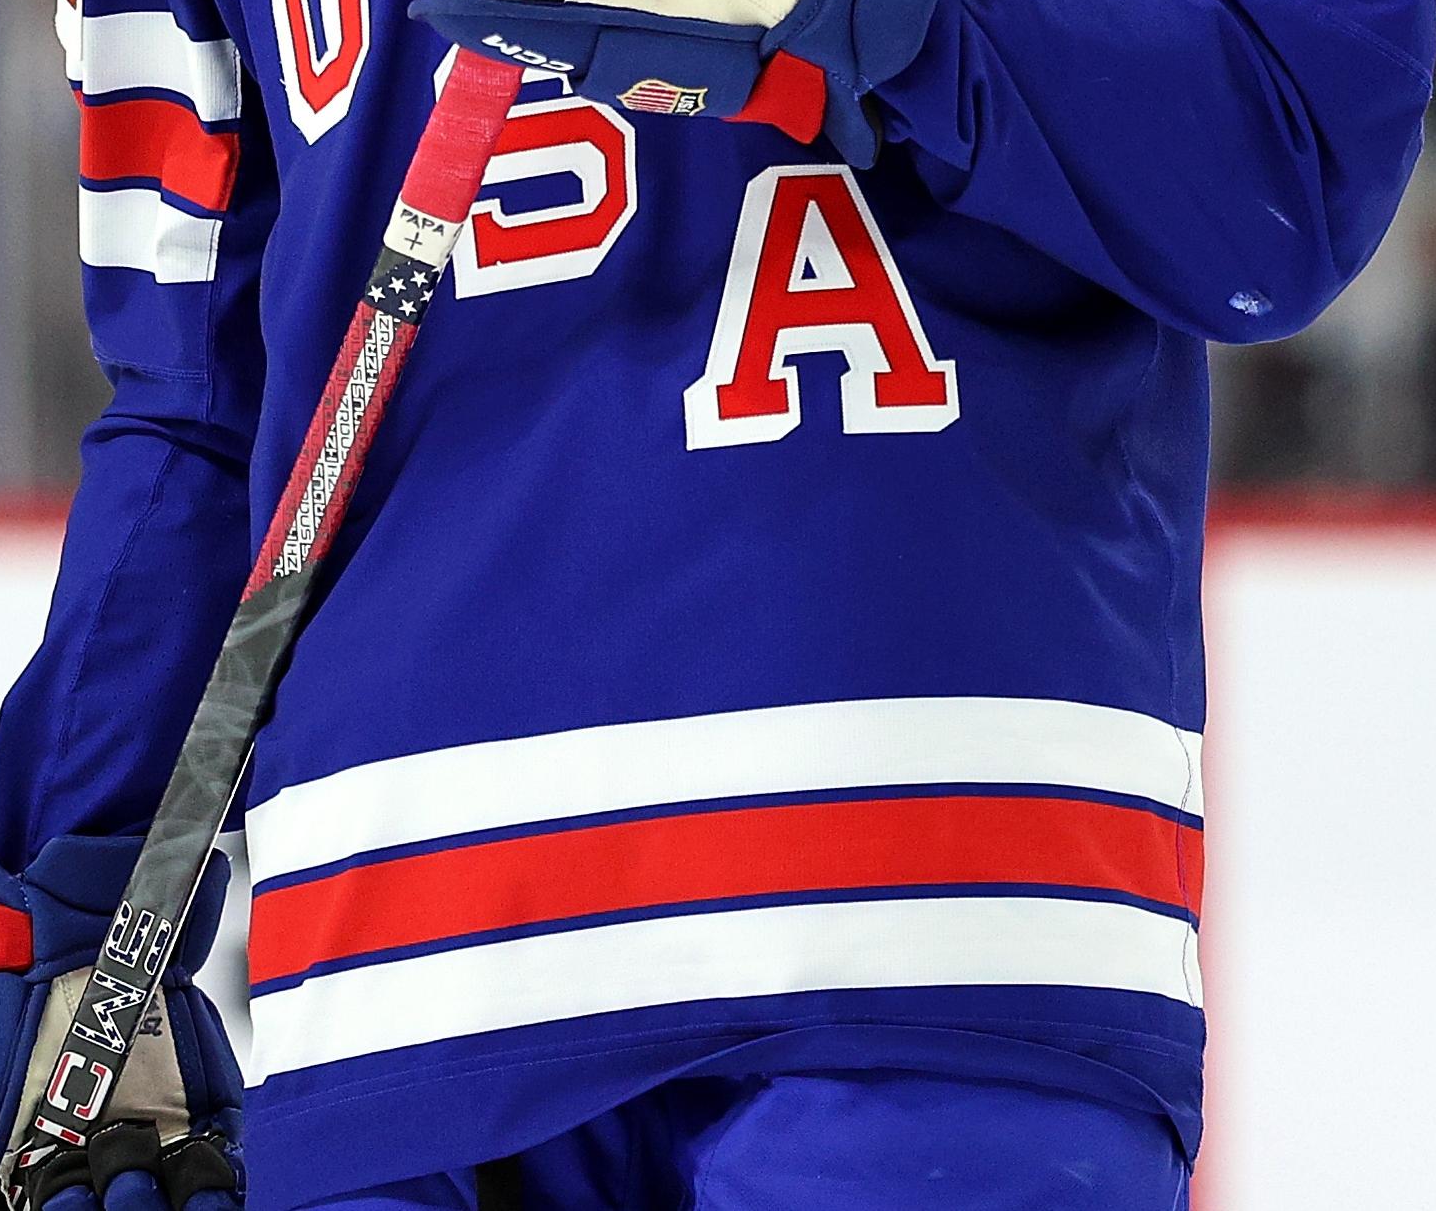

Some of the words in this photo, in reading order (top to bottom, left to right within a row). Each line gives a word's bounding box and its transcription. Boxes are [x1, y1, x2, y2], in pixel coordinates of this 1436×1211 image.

[481, 32, 575, 73] CCM
[400, 208, 445, 237] PAPA
[6, 900, 173, 1210] SMOK
